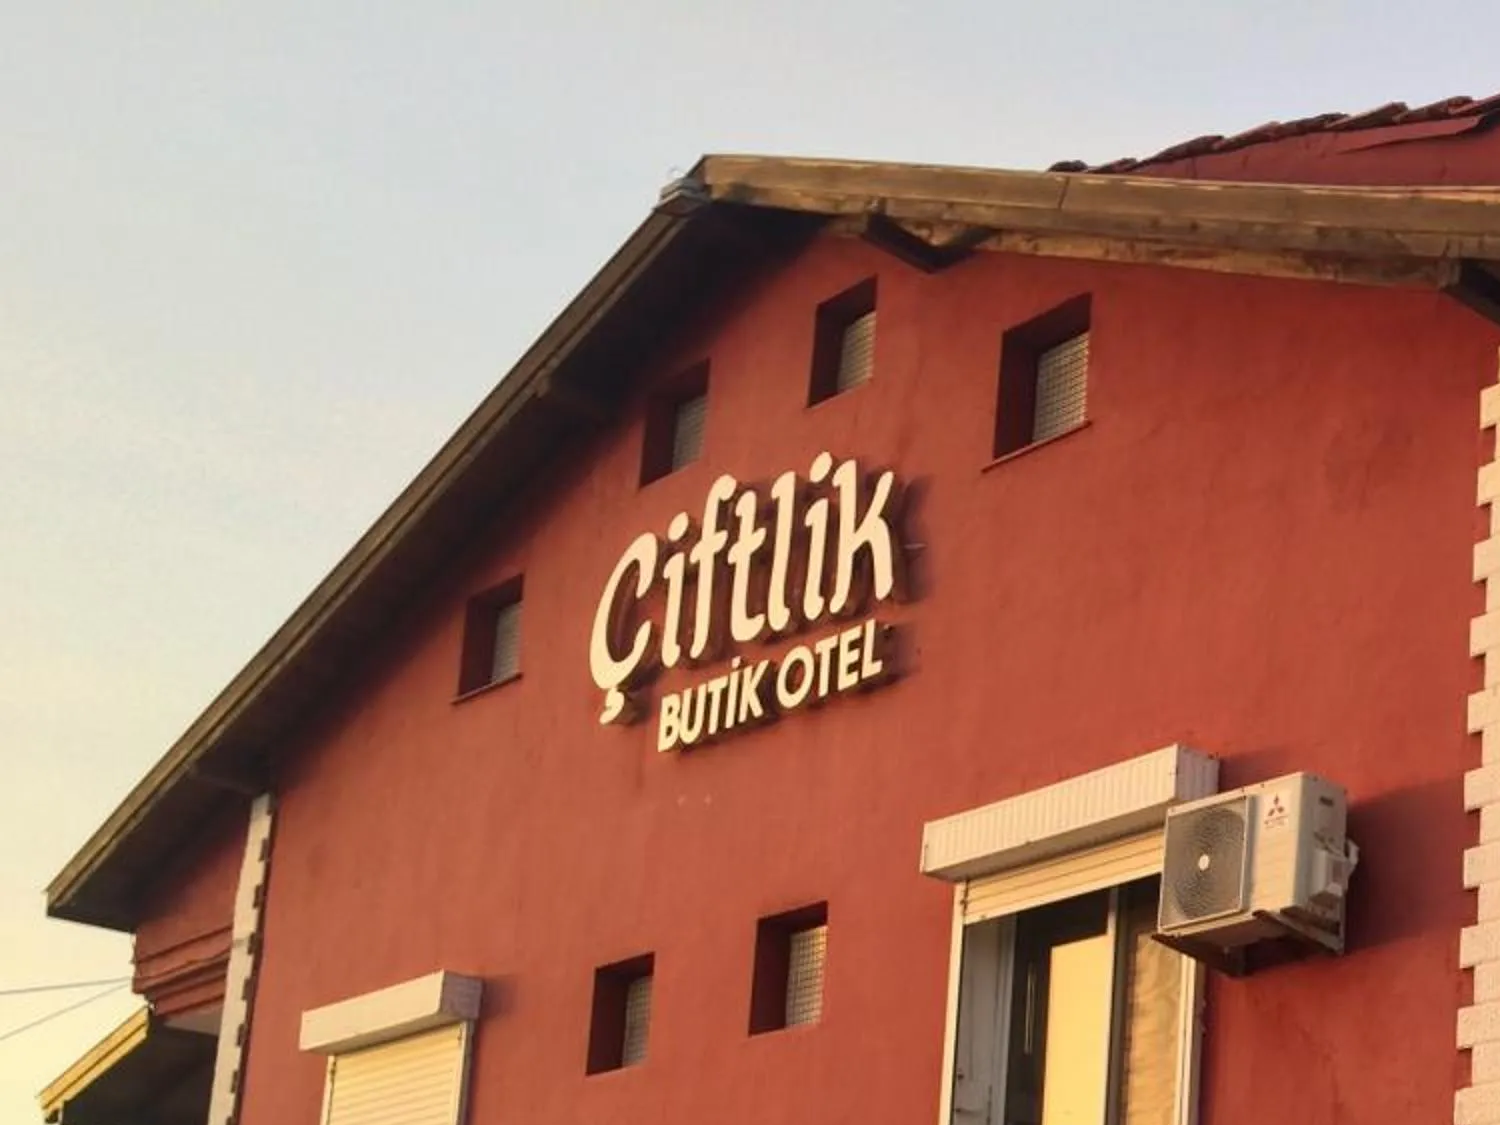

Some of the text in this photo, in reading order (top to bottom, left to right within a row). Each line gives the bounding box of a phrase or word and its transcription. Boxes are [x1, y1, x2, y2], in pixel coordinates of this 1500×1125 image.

[589, 451, 895, 725] Çiftlik
[657, 618, 884, 753] BUTİK OTEL
